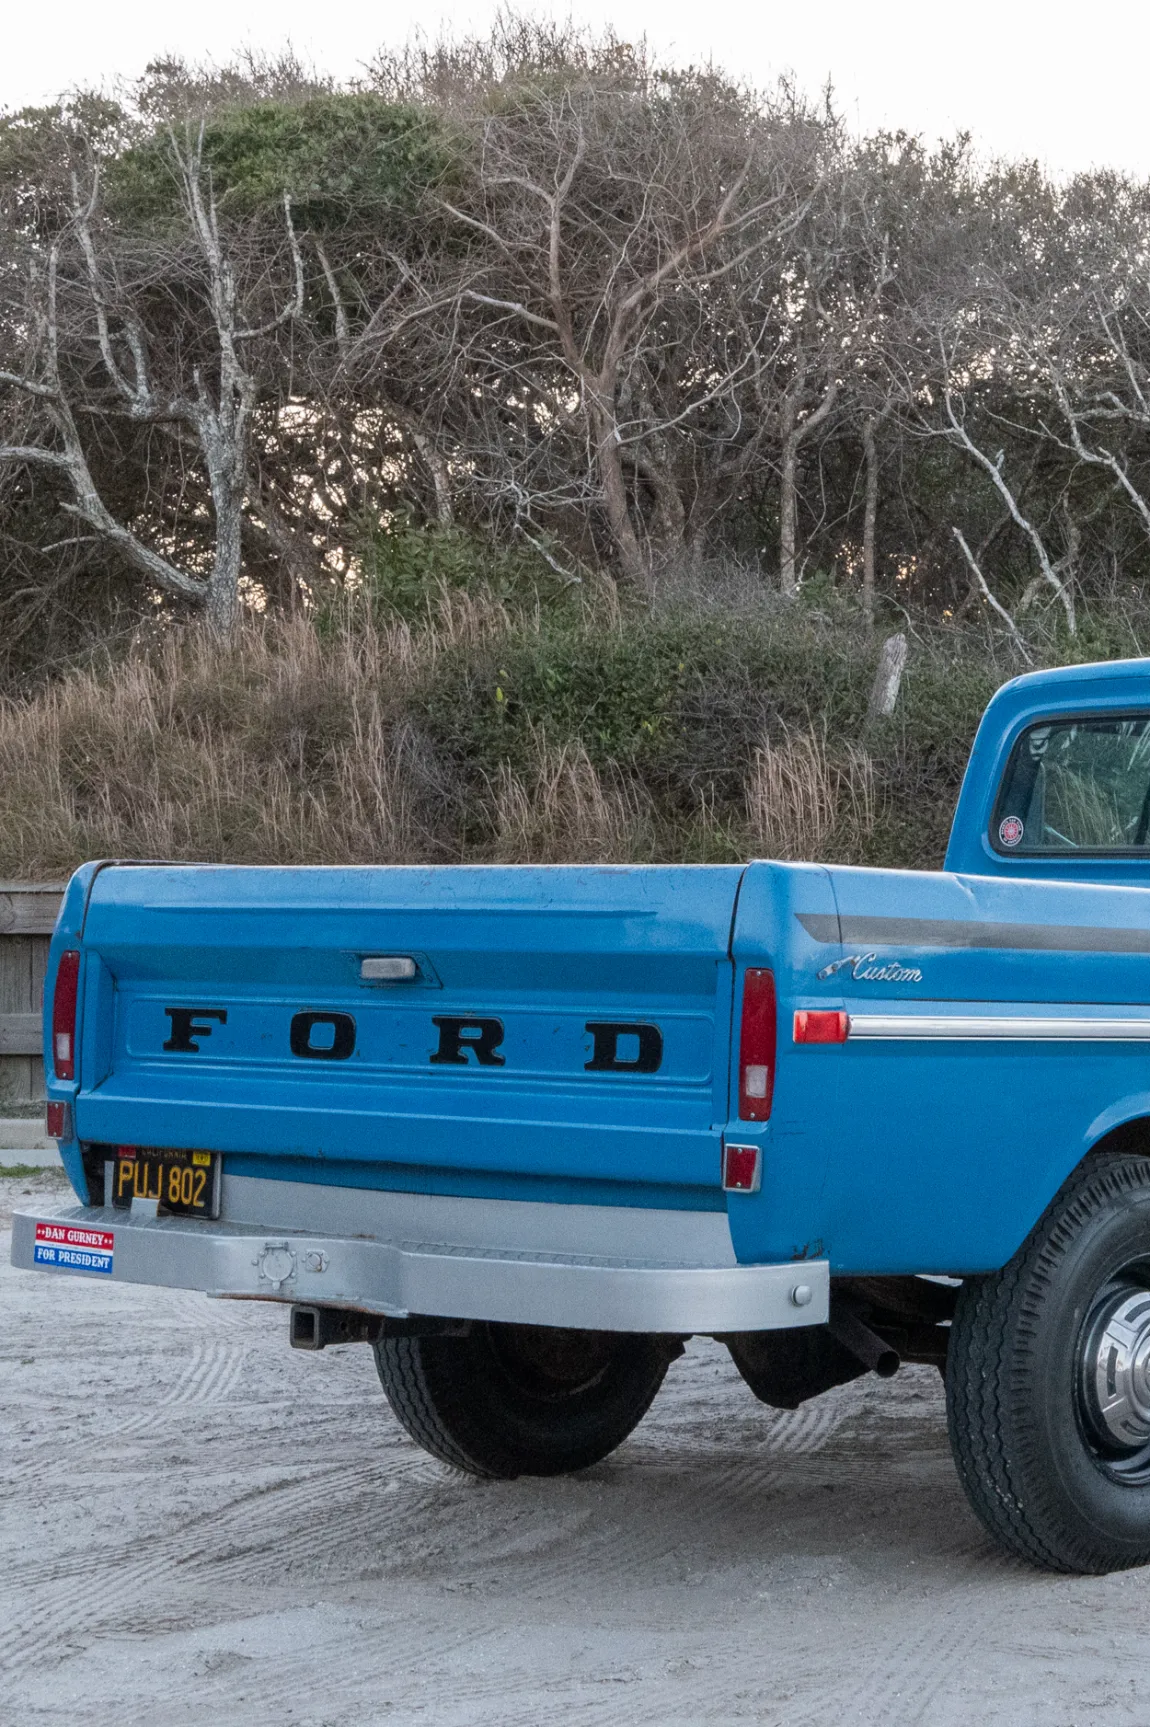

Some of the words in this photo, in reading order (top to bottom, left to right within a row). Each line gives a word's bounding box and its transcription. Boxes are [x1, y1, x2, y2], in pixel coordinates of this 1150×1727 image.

[852, 952, 923, 982] Custom
[162, 1006, 664, 1074] FORD
[118, 1160, 163, 1199] PUJ
[168, 1165, 207, 1208] 802
[45, 1226, 66, 1240] DAN
[67, 1230, 105, 1246] GURNEY
[37, 1247, 56, 1261] FOR
[58, 1250, 110, 1269] PRESIDENT
